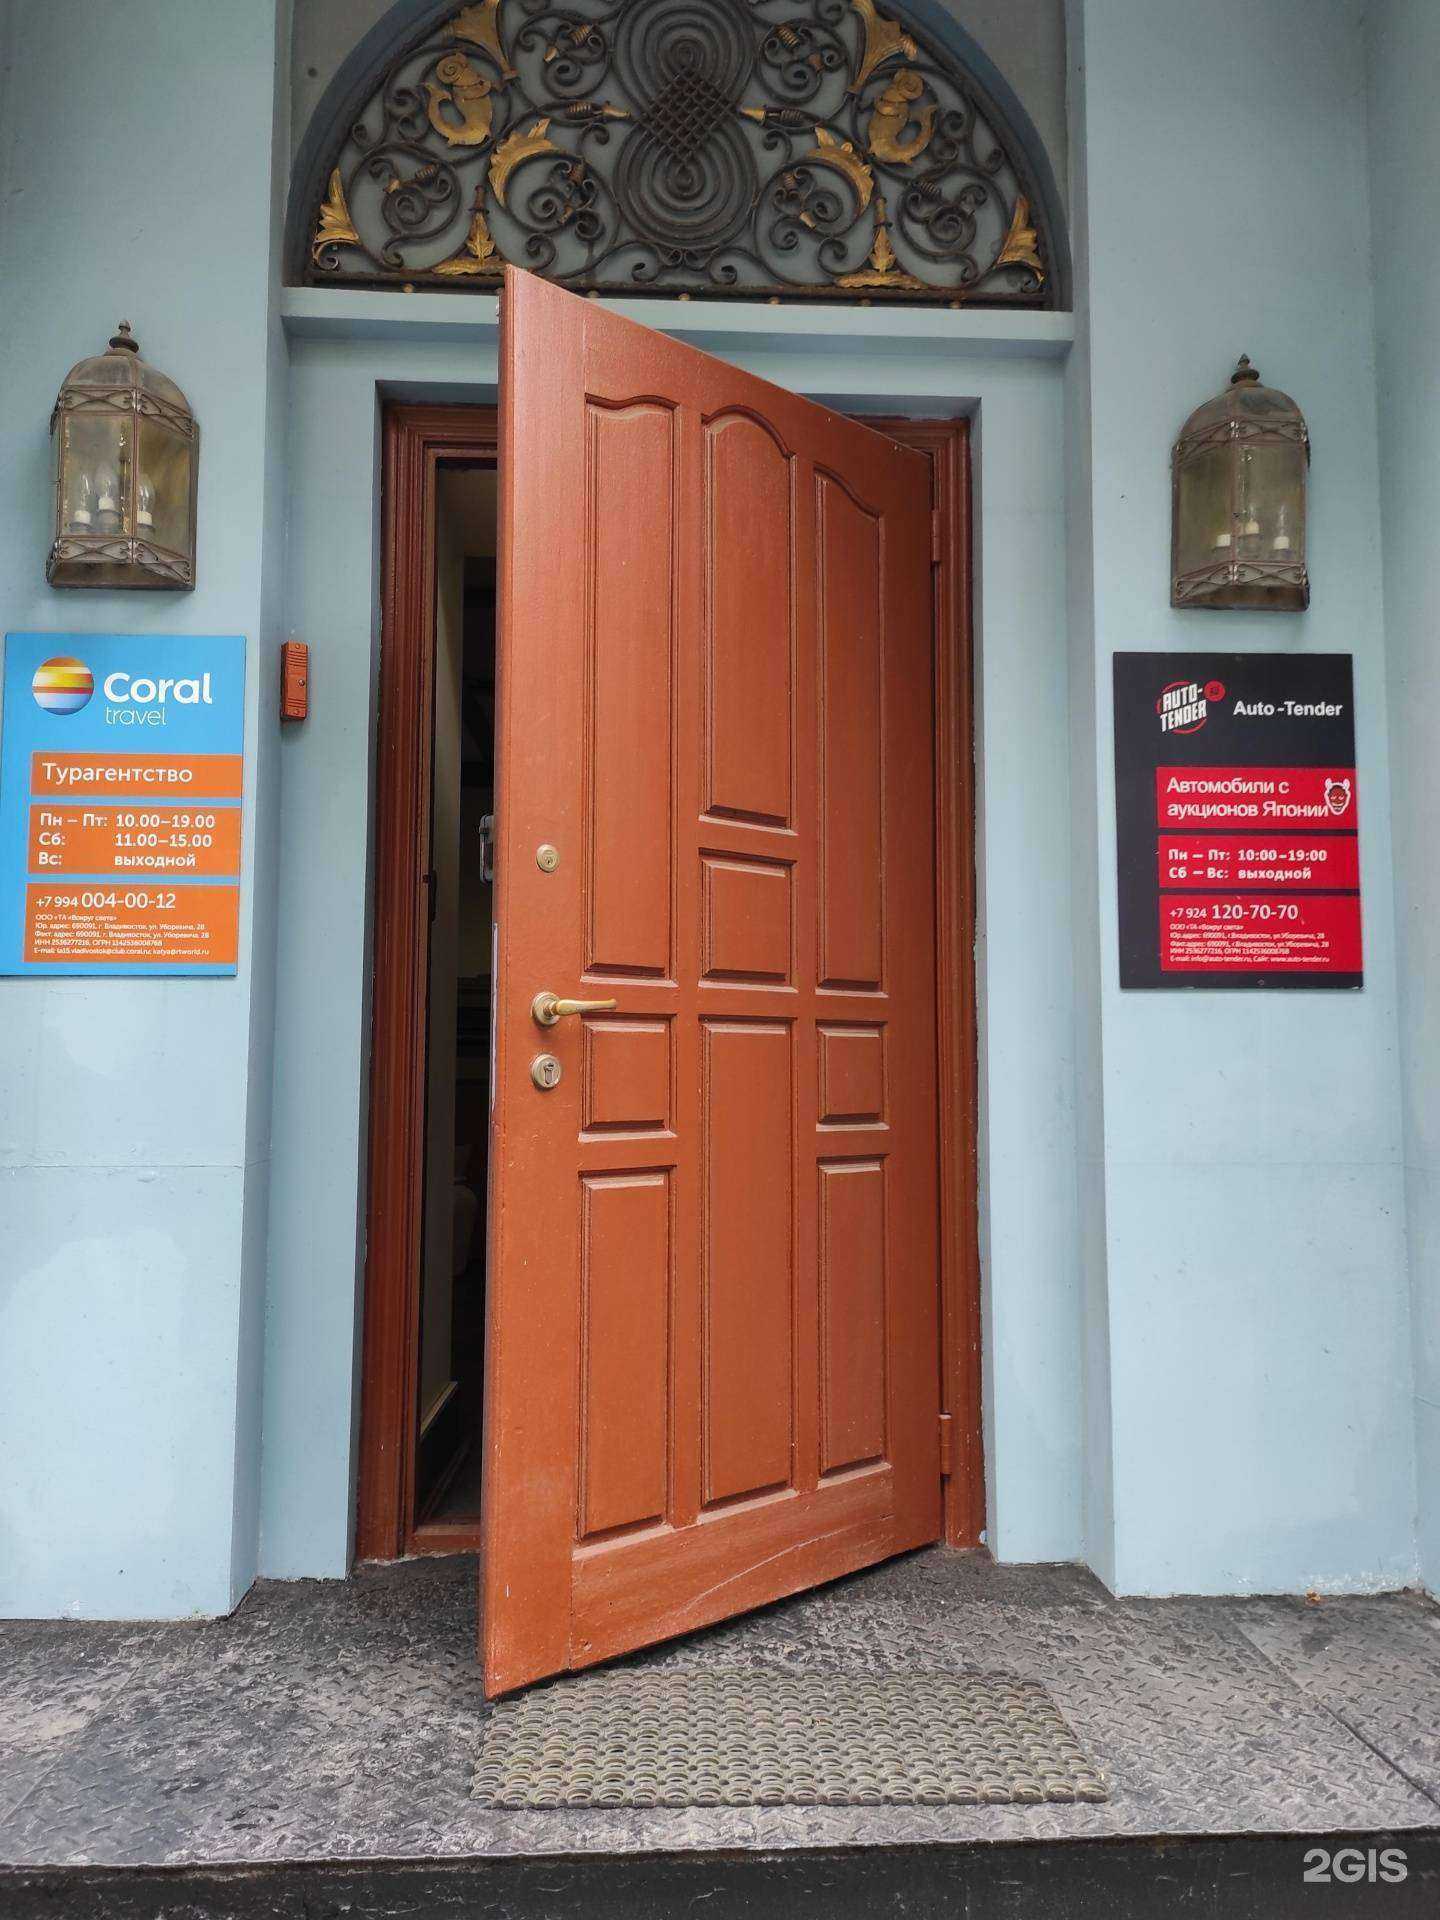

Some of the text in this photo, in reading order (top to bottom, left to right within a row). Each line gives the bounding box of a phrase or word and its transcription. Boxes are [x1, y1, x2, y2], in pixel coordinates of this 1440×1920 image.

[103, 672, 213, 704] Coral
[104, 706, 167, 726] travel
[1159, 699, 1207, 733] TENDER
[42, 762, 193, 785] Турагентство
[1166, 777, 1290, 794] Автомобили с
[1167, 801, 1329, 820] аукционов Японии
[40, 813, 63, 827] Пн
[82, 814, 108, 827] Пт:
[38, 832, 66, 846] Сб:
[38, 852, 196, 868] Вс: выходной
[1168, 849, 1188, 861] Пн
[1208, 849, 1231, 861] Пт:
[1168, 867, 1188, 879] Сб
[1207, 867, 1229, 879] Вс:
[1238, 867, 1312, 882] выходной
[35, 893, 176, 909] +7 994 004-00-12
[1169, 905, 1299, 919] +7 924 120-70-70
